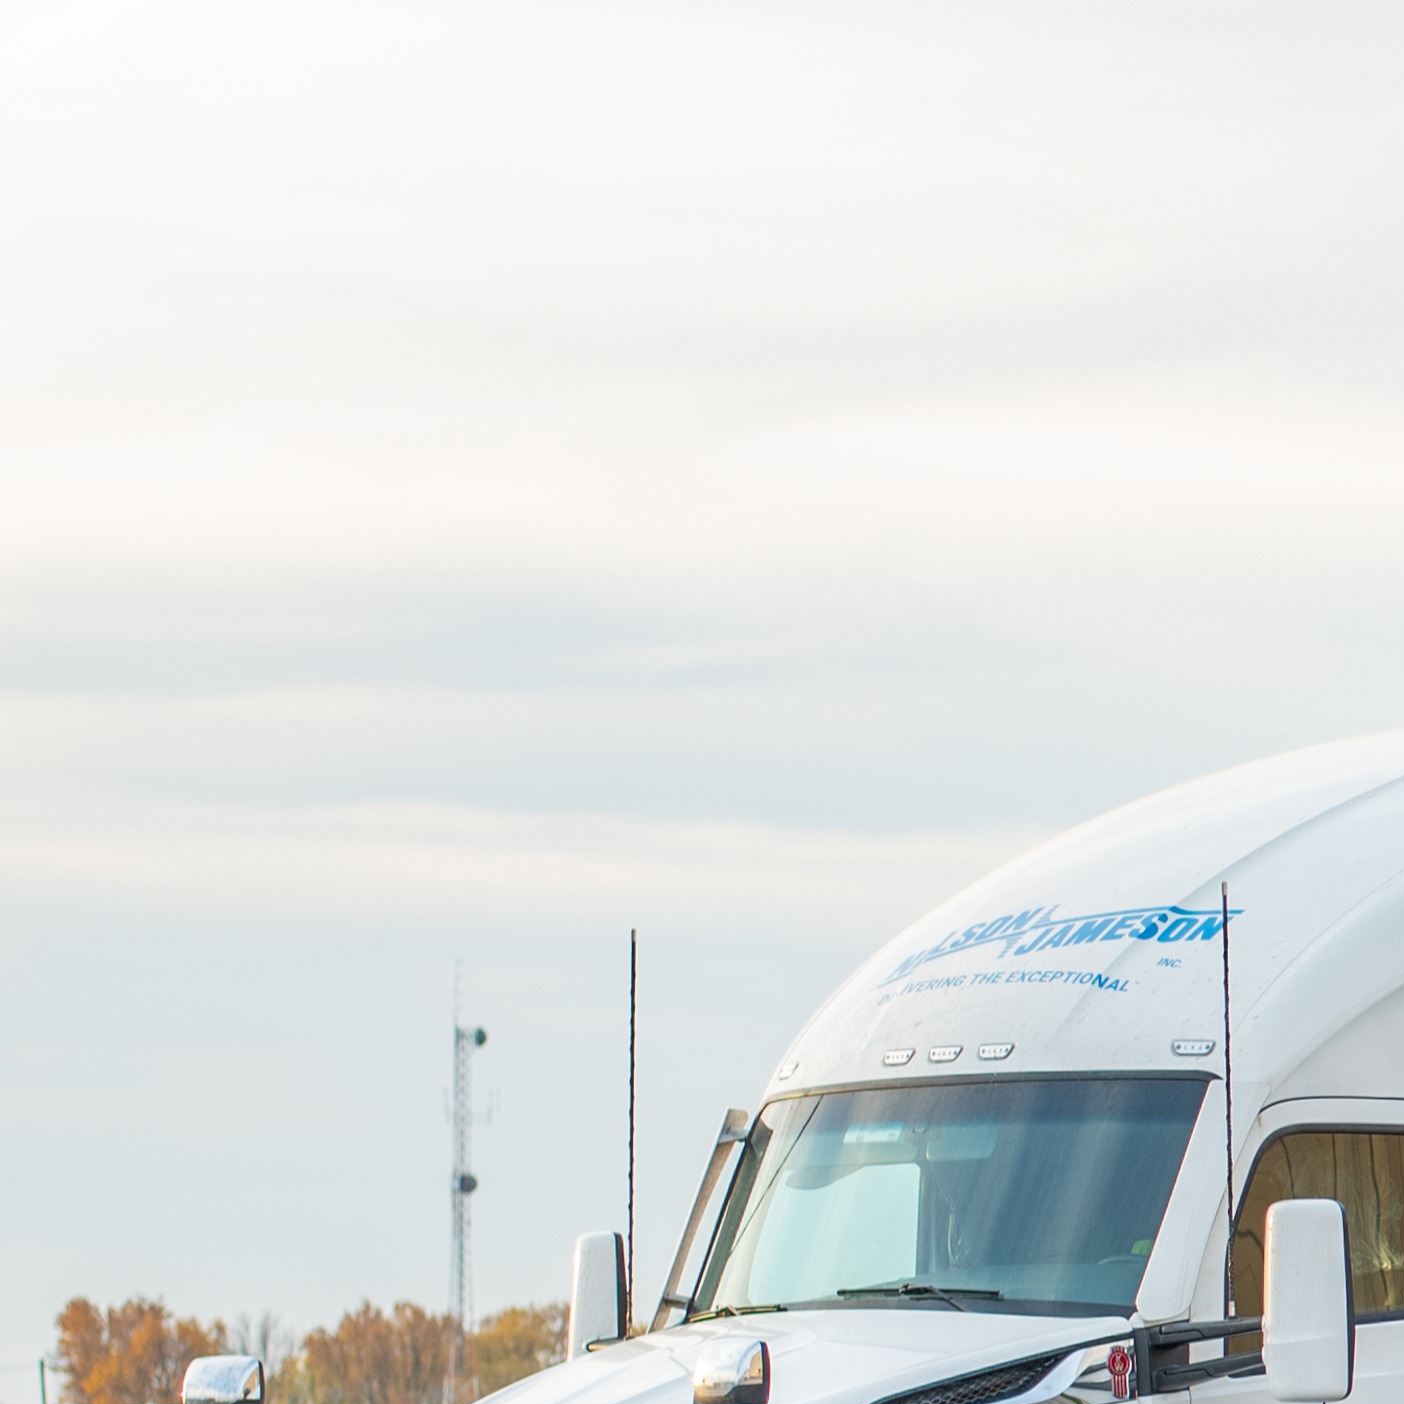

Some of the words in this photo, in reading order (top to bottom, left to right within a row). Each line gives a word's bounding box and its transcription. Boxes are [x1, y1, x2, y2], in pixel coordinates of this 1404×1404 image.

[886, 906, 1046, 981] NLSON
[1013, 913, 1233, 957] JAMESON
[1157, 957, 1182, 968] INC.
[969, 971, 1004, 985] THE
[1004, 970, 1129, 993] EXCEPTIONAL
